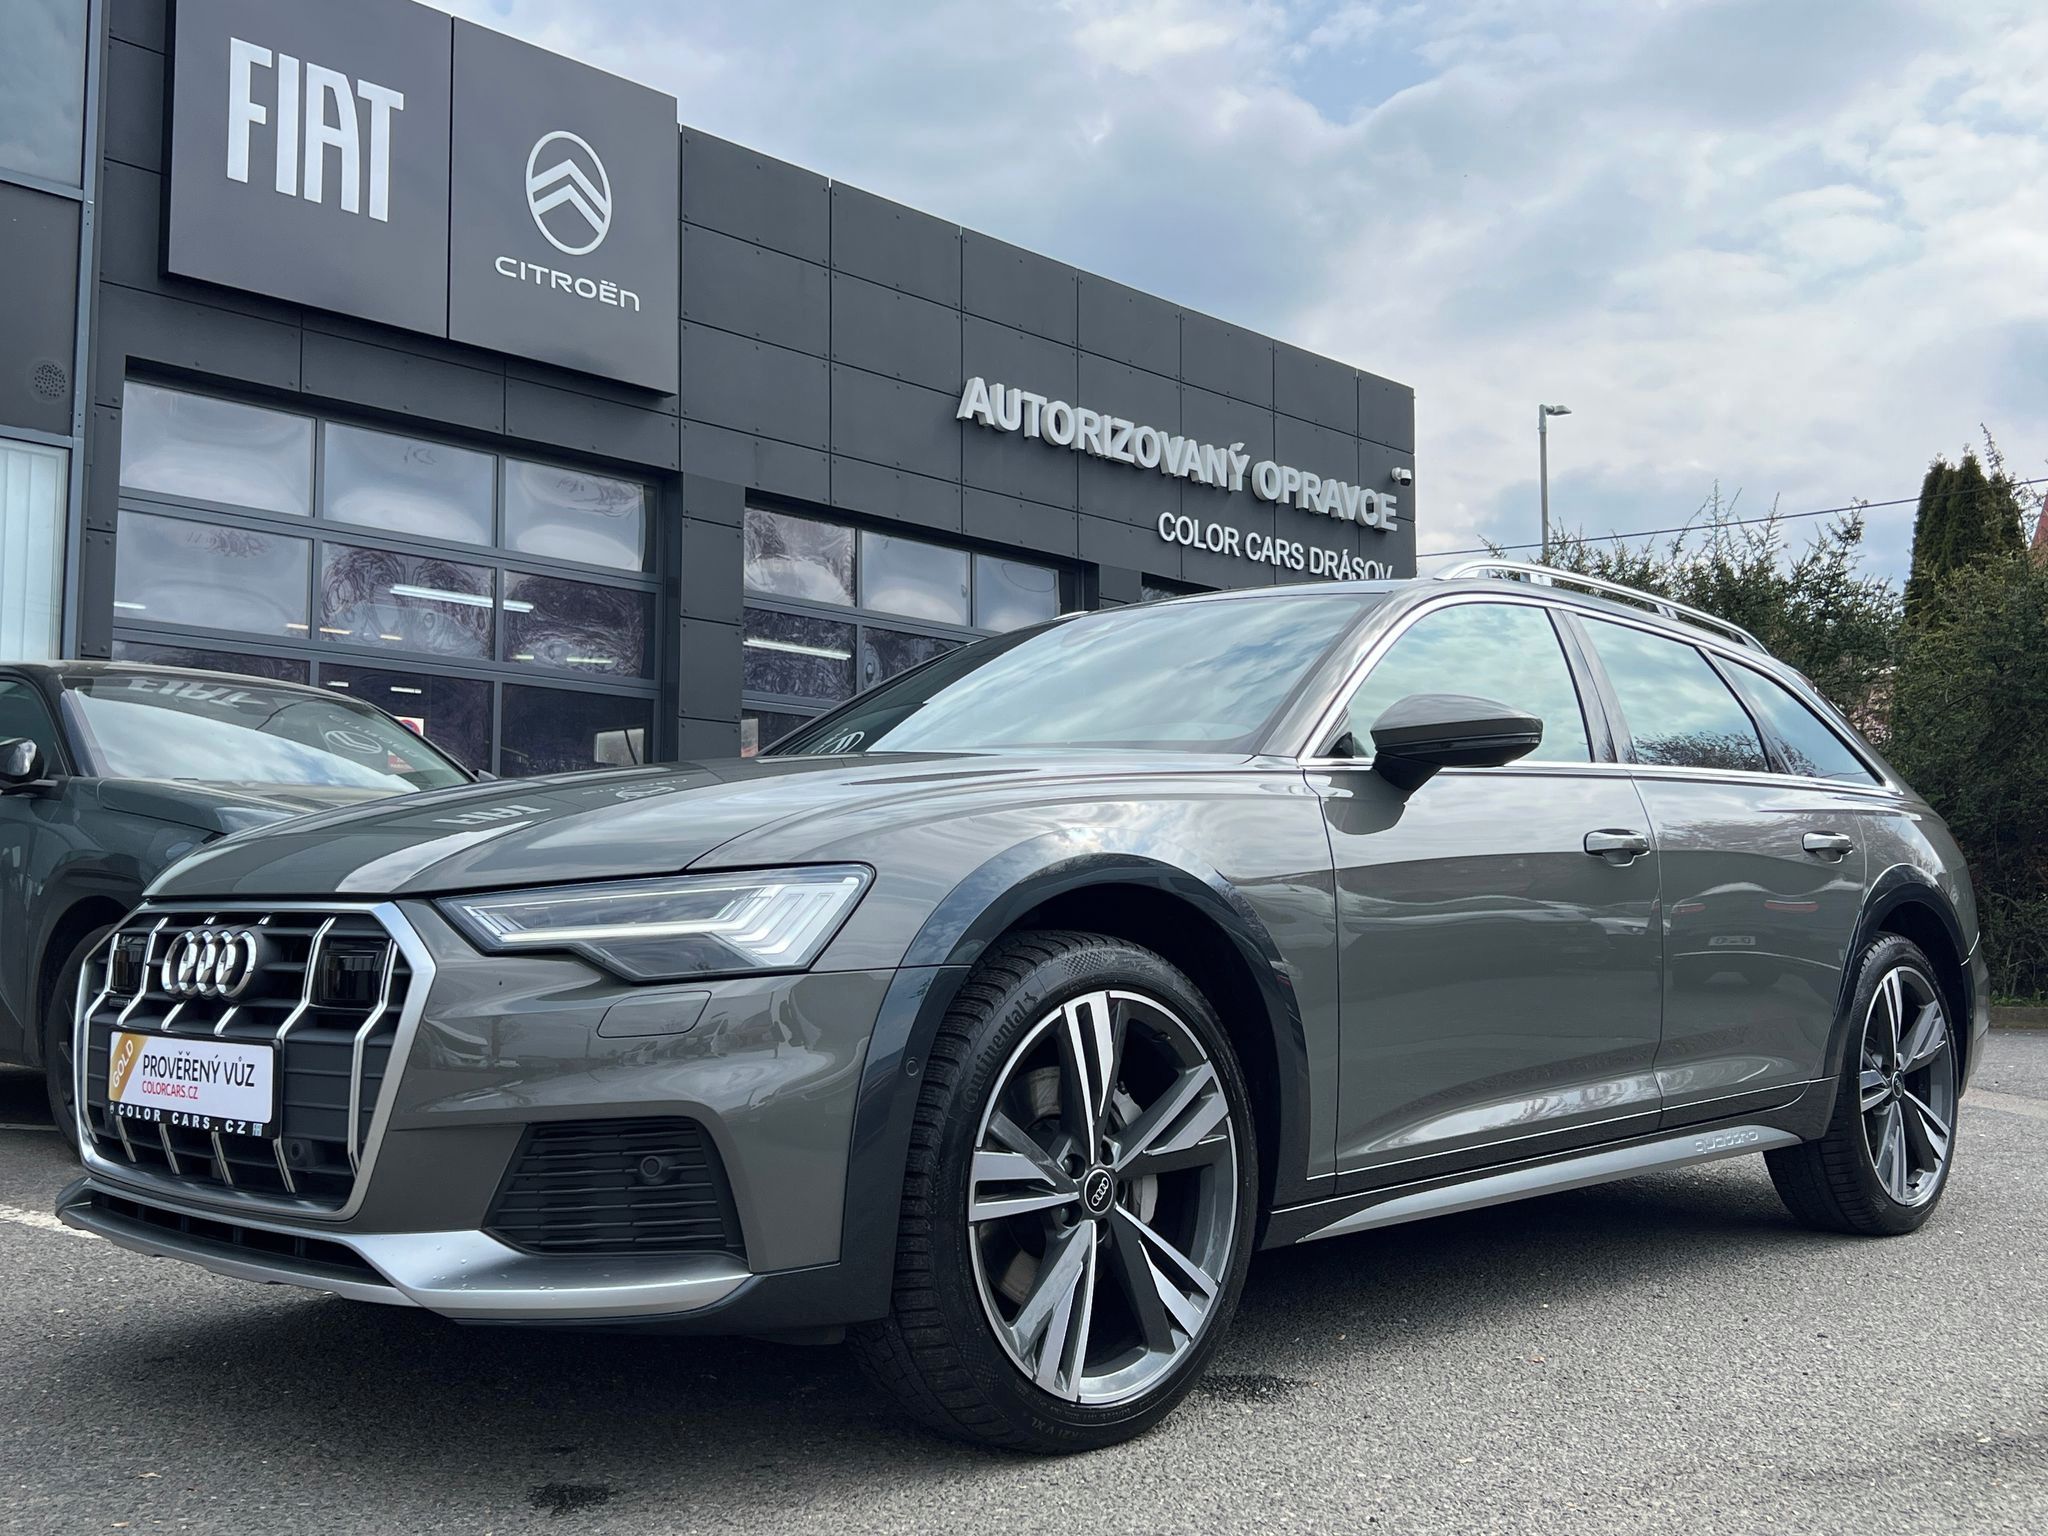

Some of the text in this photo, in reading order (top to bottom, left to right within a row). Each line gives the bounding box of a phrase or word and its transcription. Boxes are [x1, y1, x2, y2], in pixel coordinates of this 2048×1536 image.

[227, 36, 404, 222] FIAT
[956, 376, 1398, 532] AUTORIZOVANÝ OPRAVCE
[1158, 512, 1241, 557] COLOR
[1245, 532, 1305, 570] CARS
[112, 1039, 134, 1088] GOLD
[142, 1050, 255, 1087] PROVĚŘENÝ VŮZ
[118, 1103, 161, 1123] COLOR
[142, 1080, 199, 1100] COLORCARS.CZ
